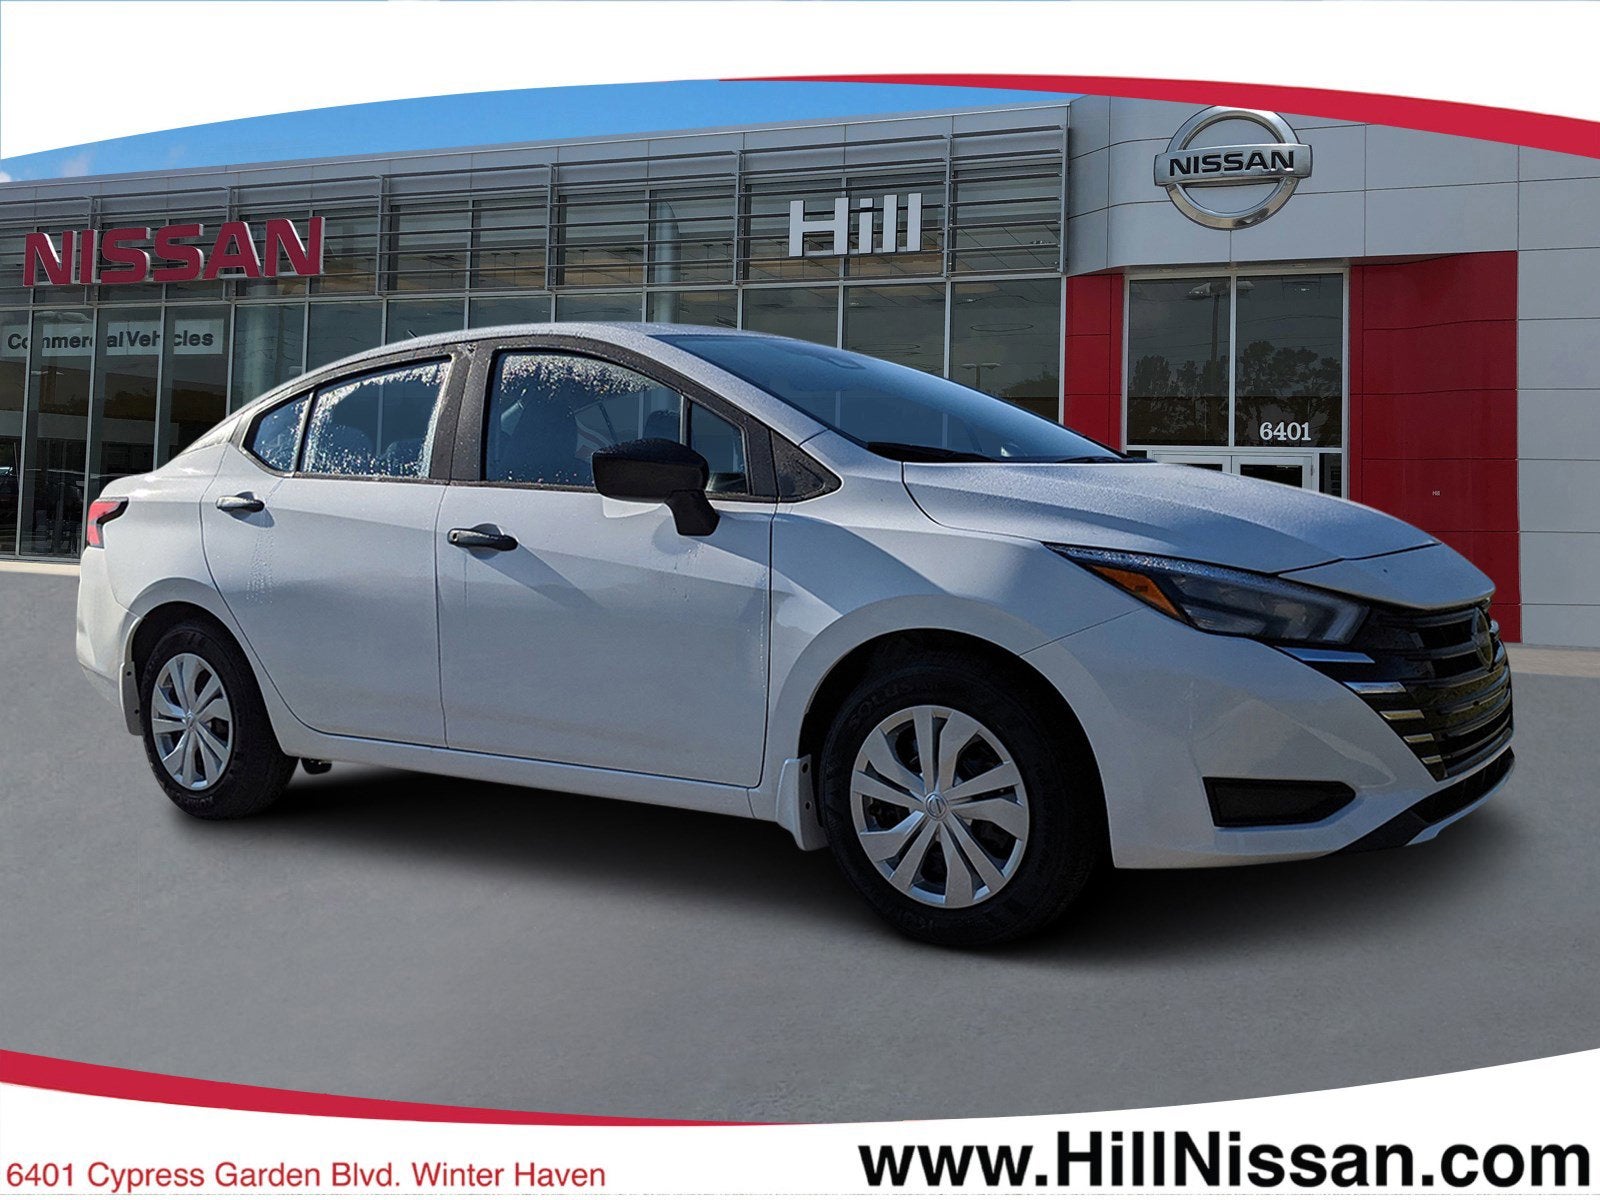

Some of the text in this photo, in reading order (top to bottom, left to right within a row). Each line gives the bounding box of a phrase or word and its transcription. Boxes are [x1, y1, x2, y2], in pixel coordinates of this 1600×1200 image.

[1169, 151, 1294, 177] NISSAN
[788, 193, 922, 257] Hill
[23, 216, 325, 287] NISSAN
[8, 330, 214, 349] Commeral Vehcles
[1259, 421, 1312, 441] 6401
